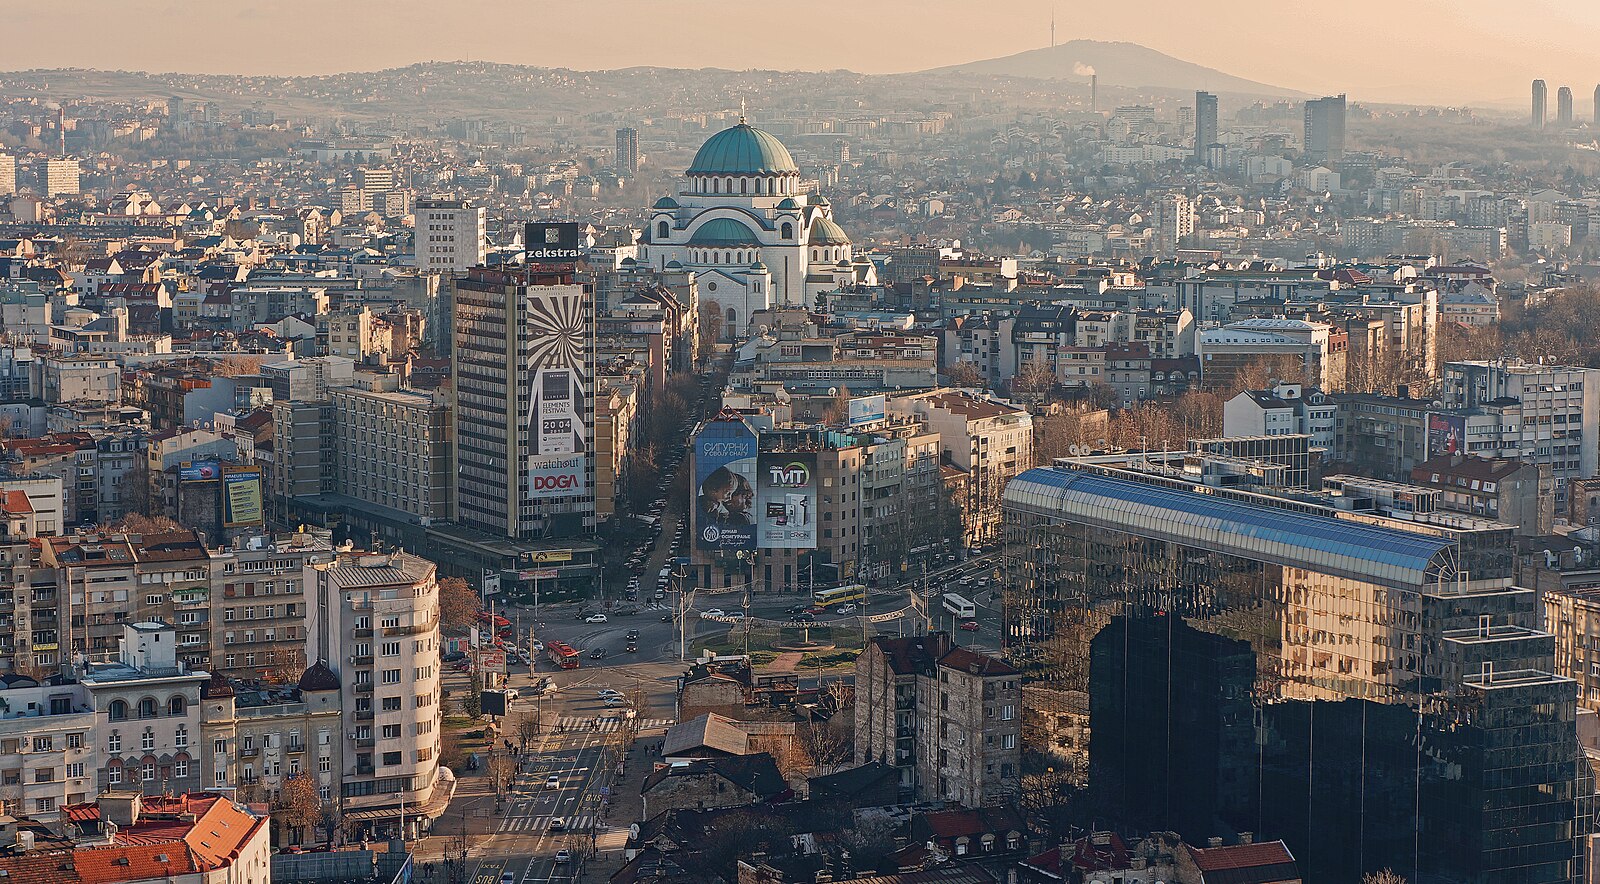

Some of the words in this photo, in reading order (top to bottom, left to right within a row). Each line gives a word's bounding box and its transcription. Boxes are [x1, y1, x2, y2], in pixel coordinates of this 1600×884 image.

[528, 248, 577, 258] zekstra
[544, 421, 556, 429] 20
[558, 420, 571, 428] 04
[704, 442, 748, 452] СИГУРНИ
[534, 458, 578, 469] watchout
[534, 474, 578, 490] DOGA
